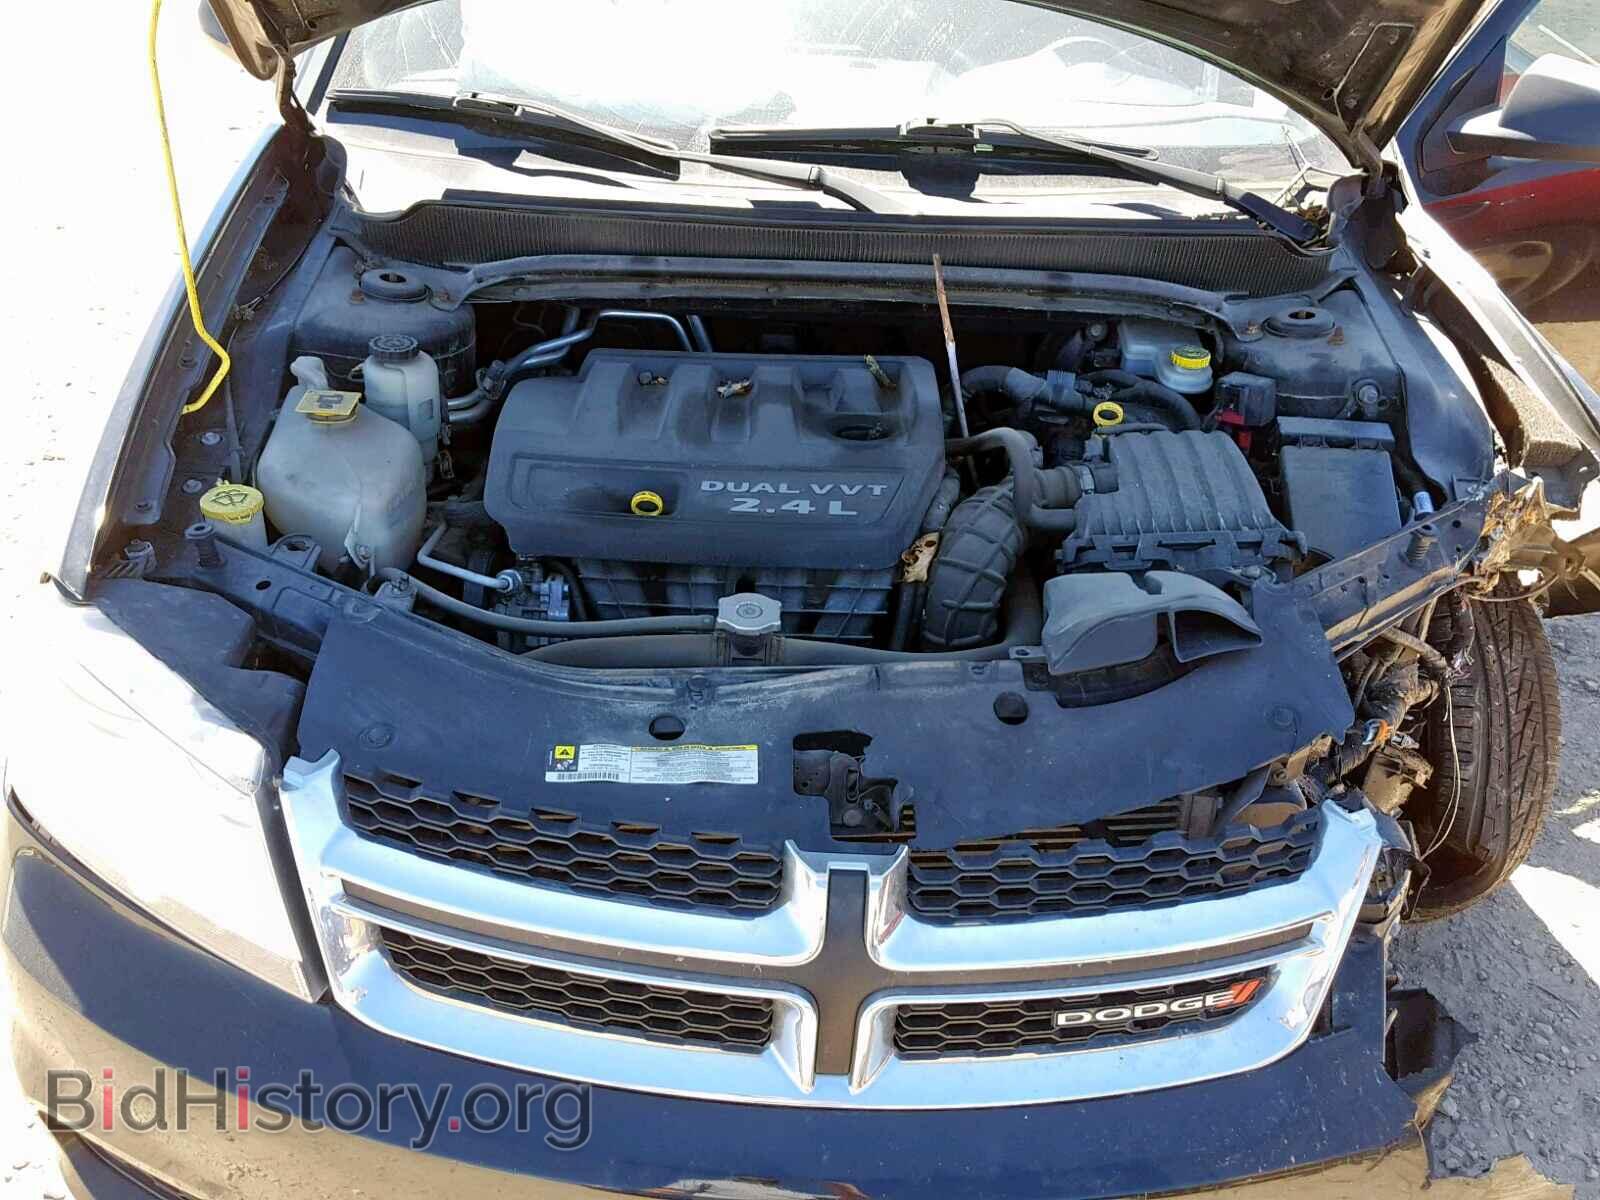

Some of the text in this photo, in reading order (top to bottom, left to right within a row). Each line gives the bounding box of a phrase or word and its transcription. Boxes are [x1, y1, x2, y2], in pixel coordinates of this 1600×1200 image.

[700, 480, 888, 496] DUAL VVT
[1056, 990, 1234, 1026] DODGE
